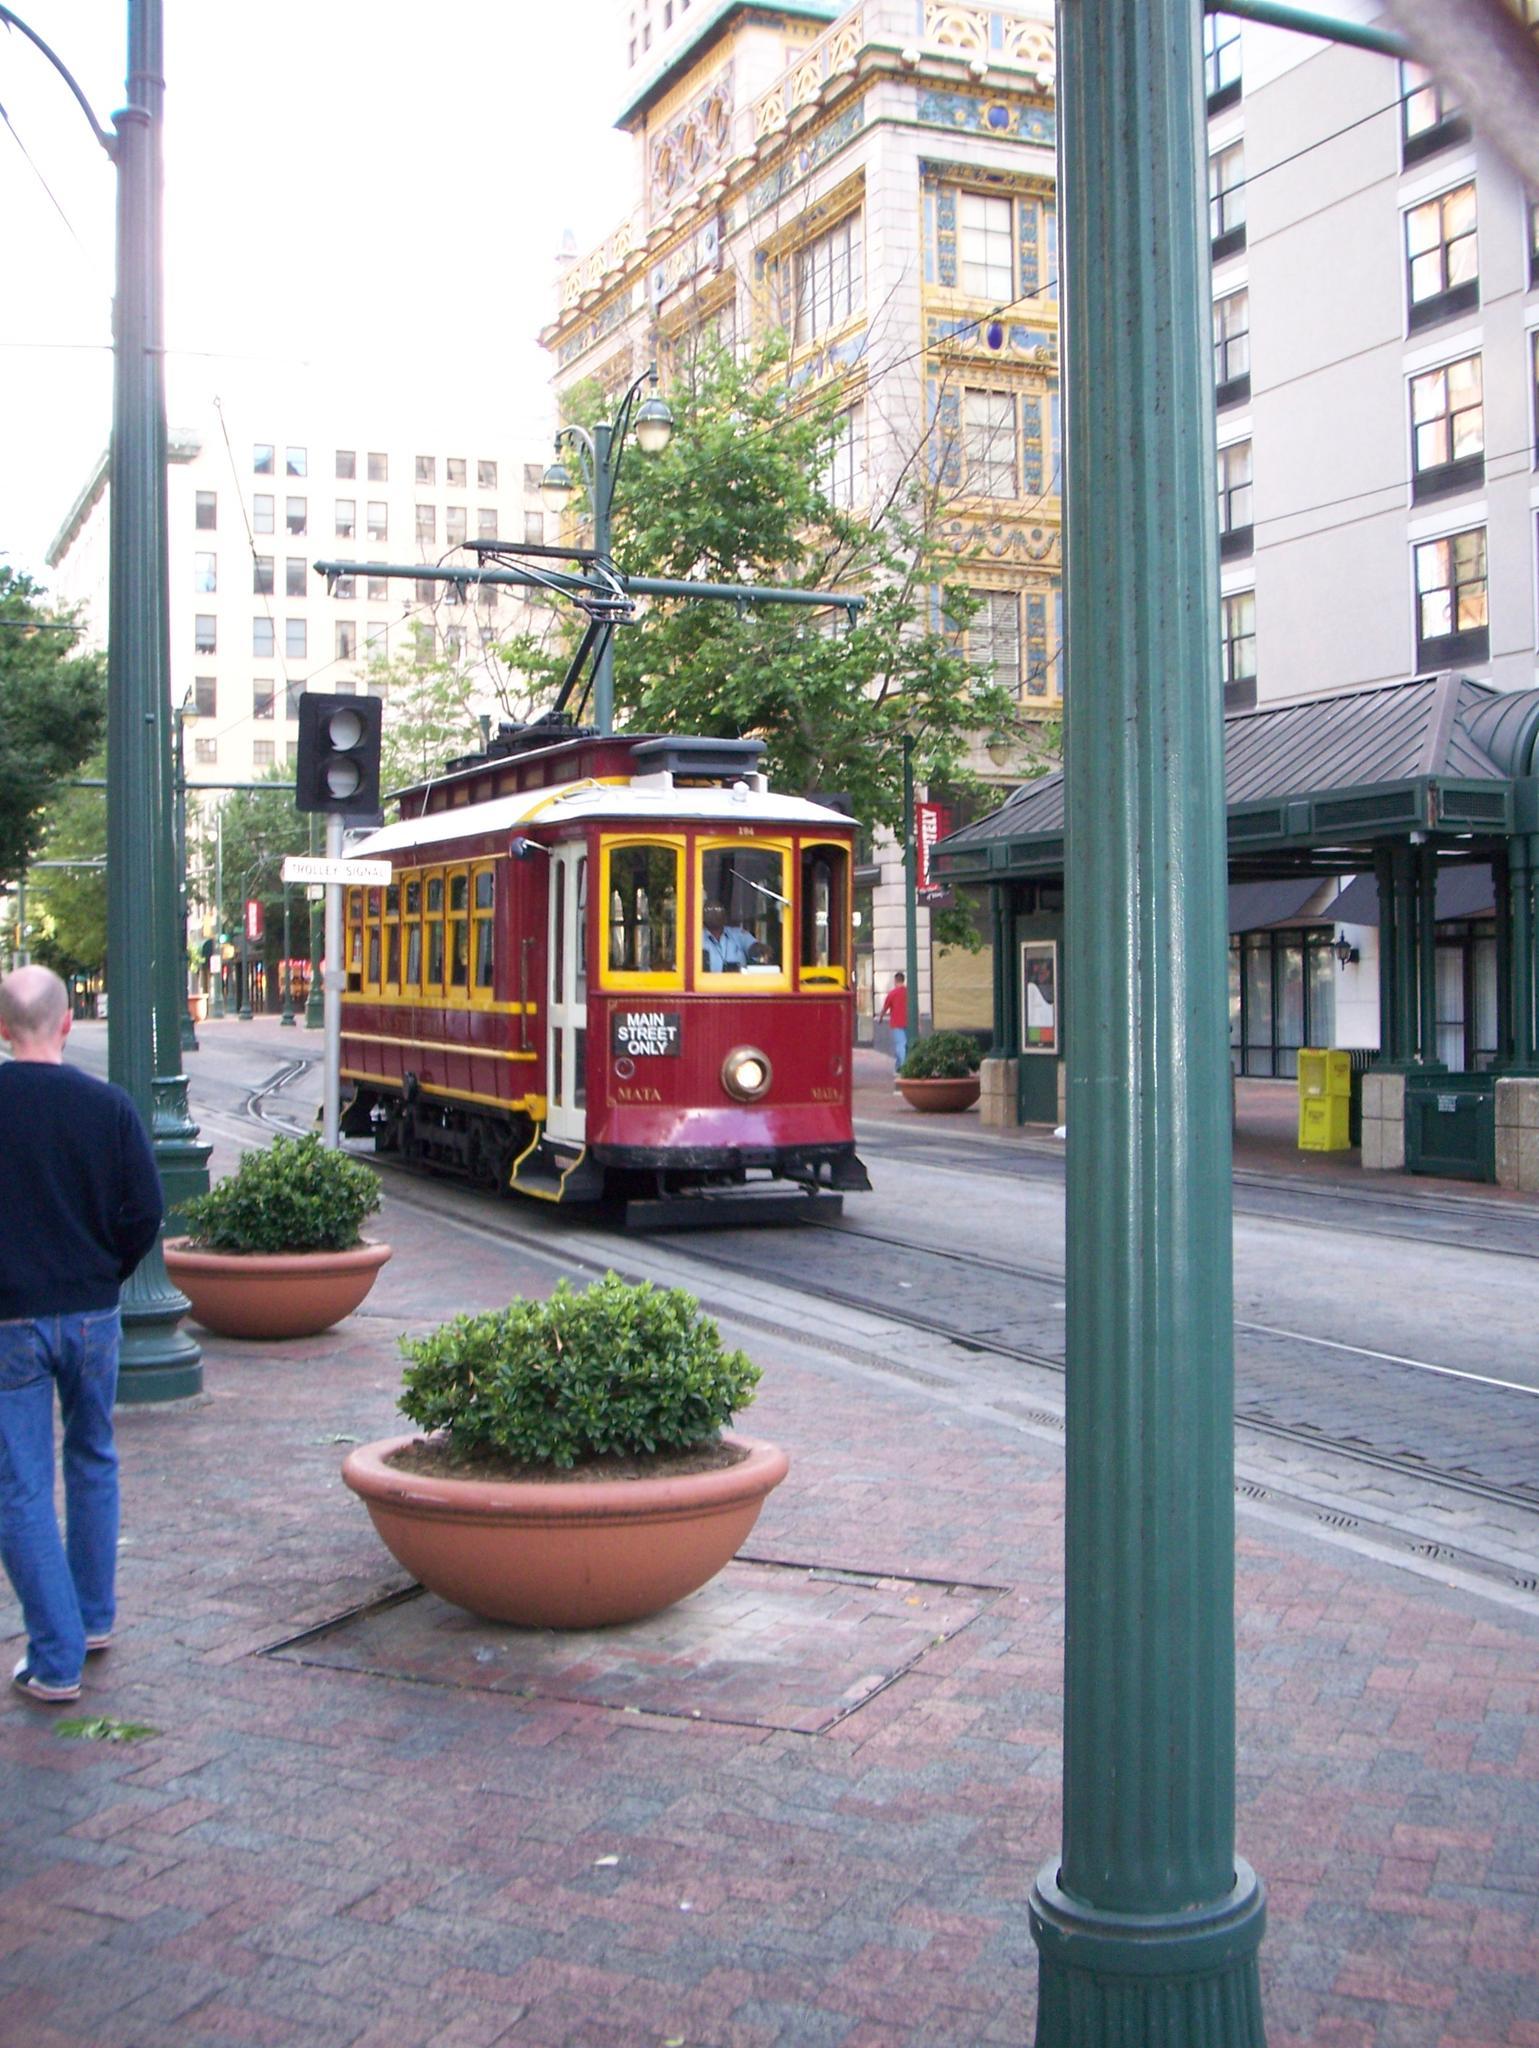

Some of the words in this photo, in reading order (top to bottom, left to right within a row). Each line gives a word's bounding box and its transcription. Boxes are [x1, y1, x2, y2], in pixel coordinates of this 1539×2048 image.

[292, 863, 337, 876] TROLLEY
[346, 866, 384, 878] SIGNAL
[627, 1012, 665, 1027] MAIN
[618, 1026, 677, 1041] STREET
[628, 1040, 668, 1056] ONLY
[618, 1087, 662, 1102] MATA
